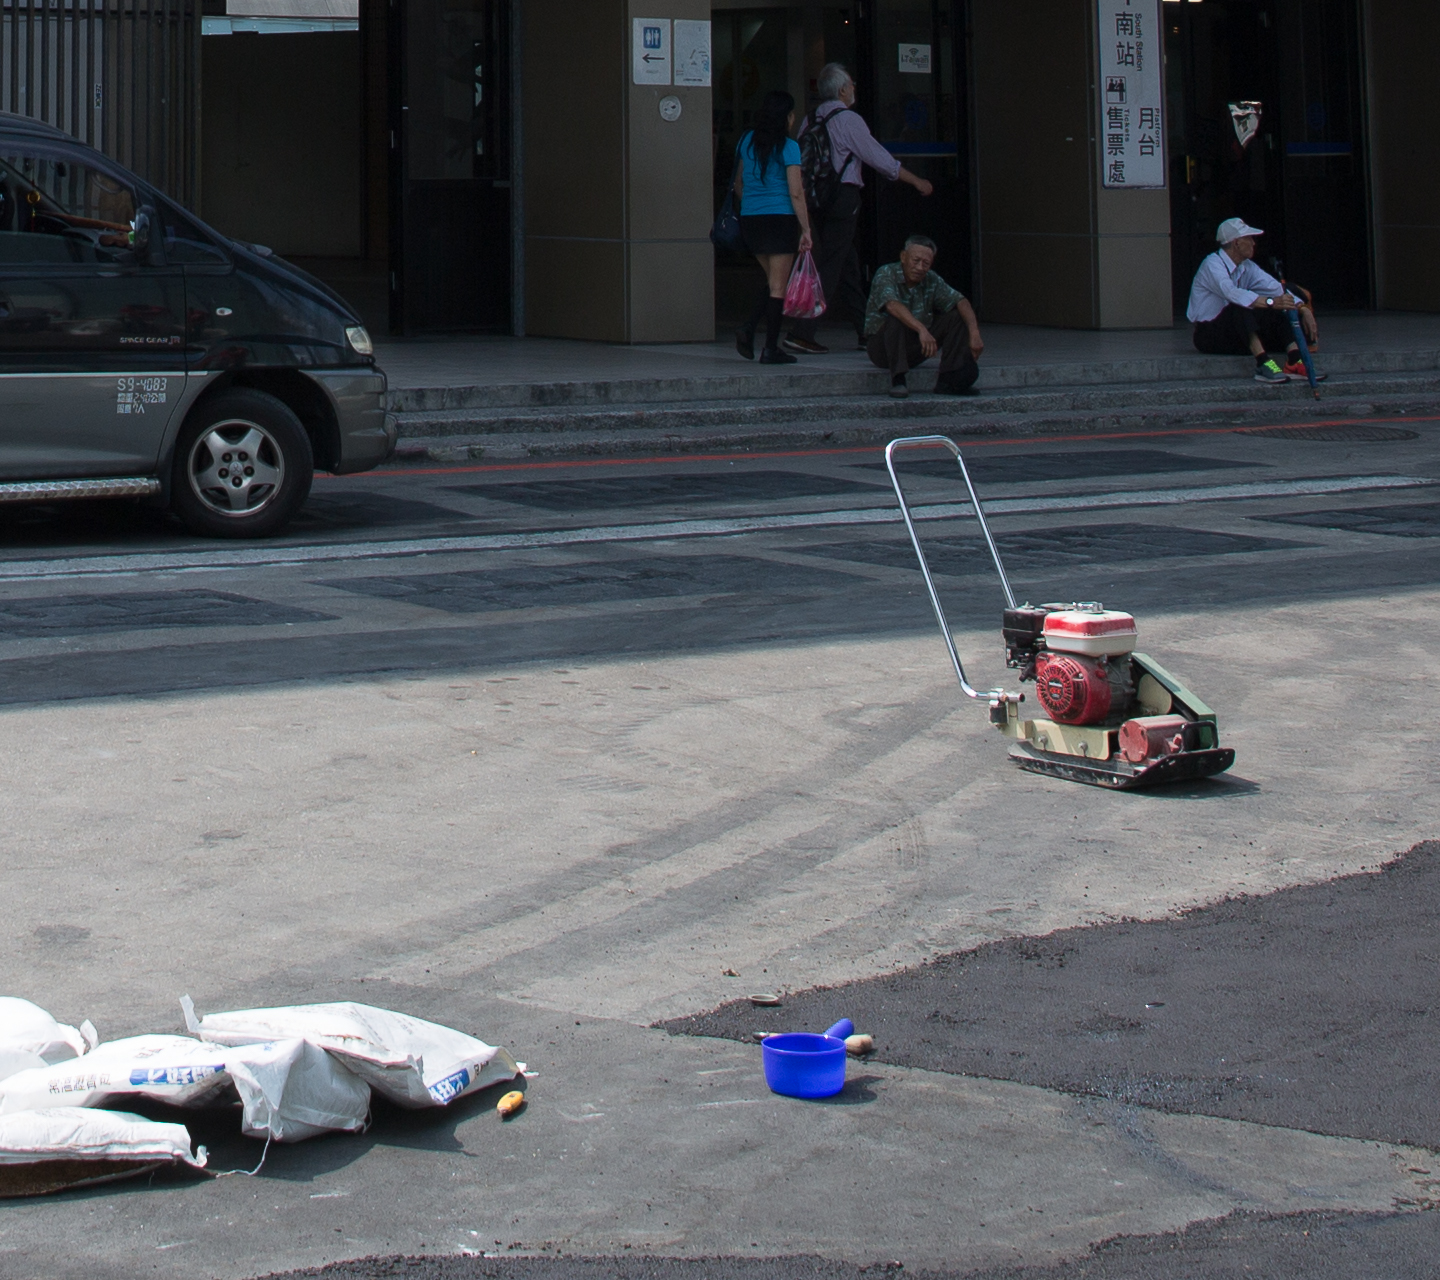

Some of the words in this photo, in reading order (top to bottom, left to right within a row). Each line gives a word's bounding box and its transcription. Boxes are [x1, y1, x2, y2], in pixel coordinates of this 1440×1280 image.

[1115, 11, 1135, 67] 南站
[1134, 12, 1143, 39] South
[1135, 41, 1144, 72] Station
[1106, 106, 1126, 184] 售票處
[1138, 107, 1155, 157] 月台
[119, 336, 145, 344] SPACE
[146, 336, 168, 344] GEAR
[117, 377, 168, 392] S9-4083
